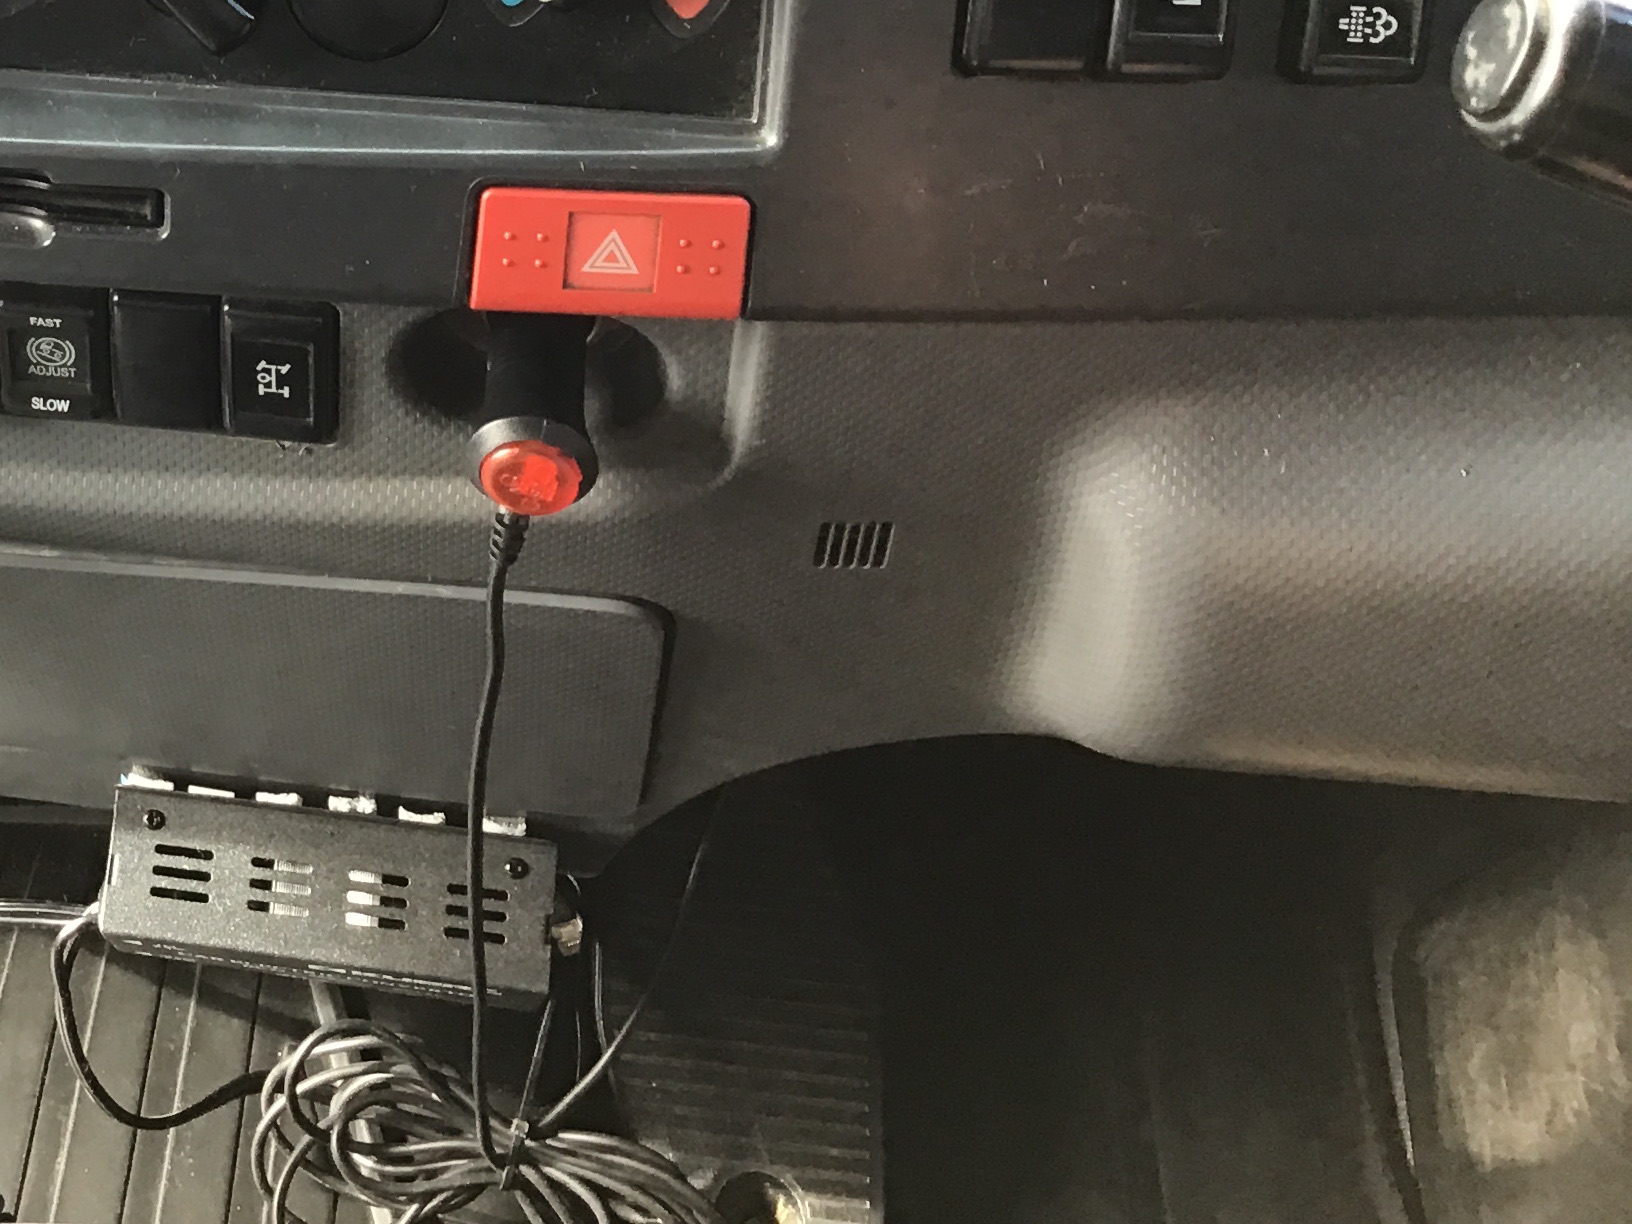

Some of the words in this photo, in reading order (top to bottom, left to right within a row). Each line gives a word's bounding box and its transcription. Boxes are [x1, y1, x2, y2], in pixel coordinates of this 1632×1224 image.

[29, 316, 62, 328] FAST
[28, 364, 77, 378] ADJUST
[31, 396, 70, 412] SLOW
